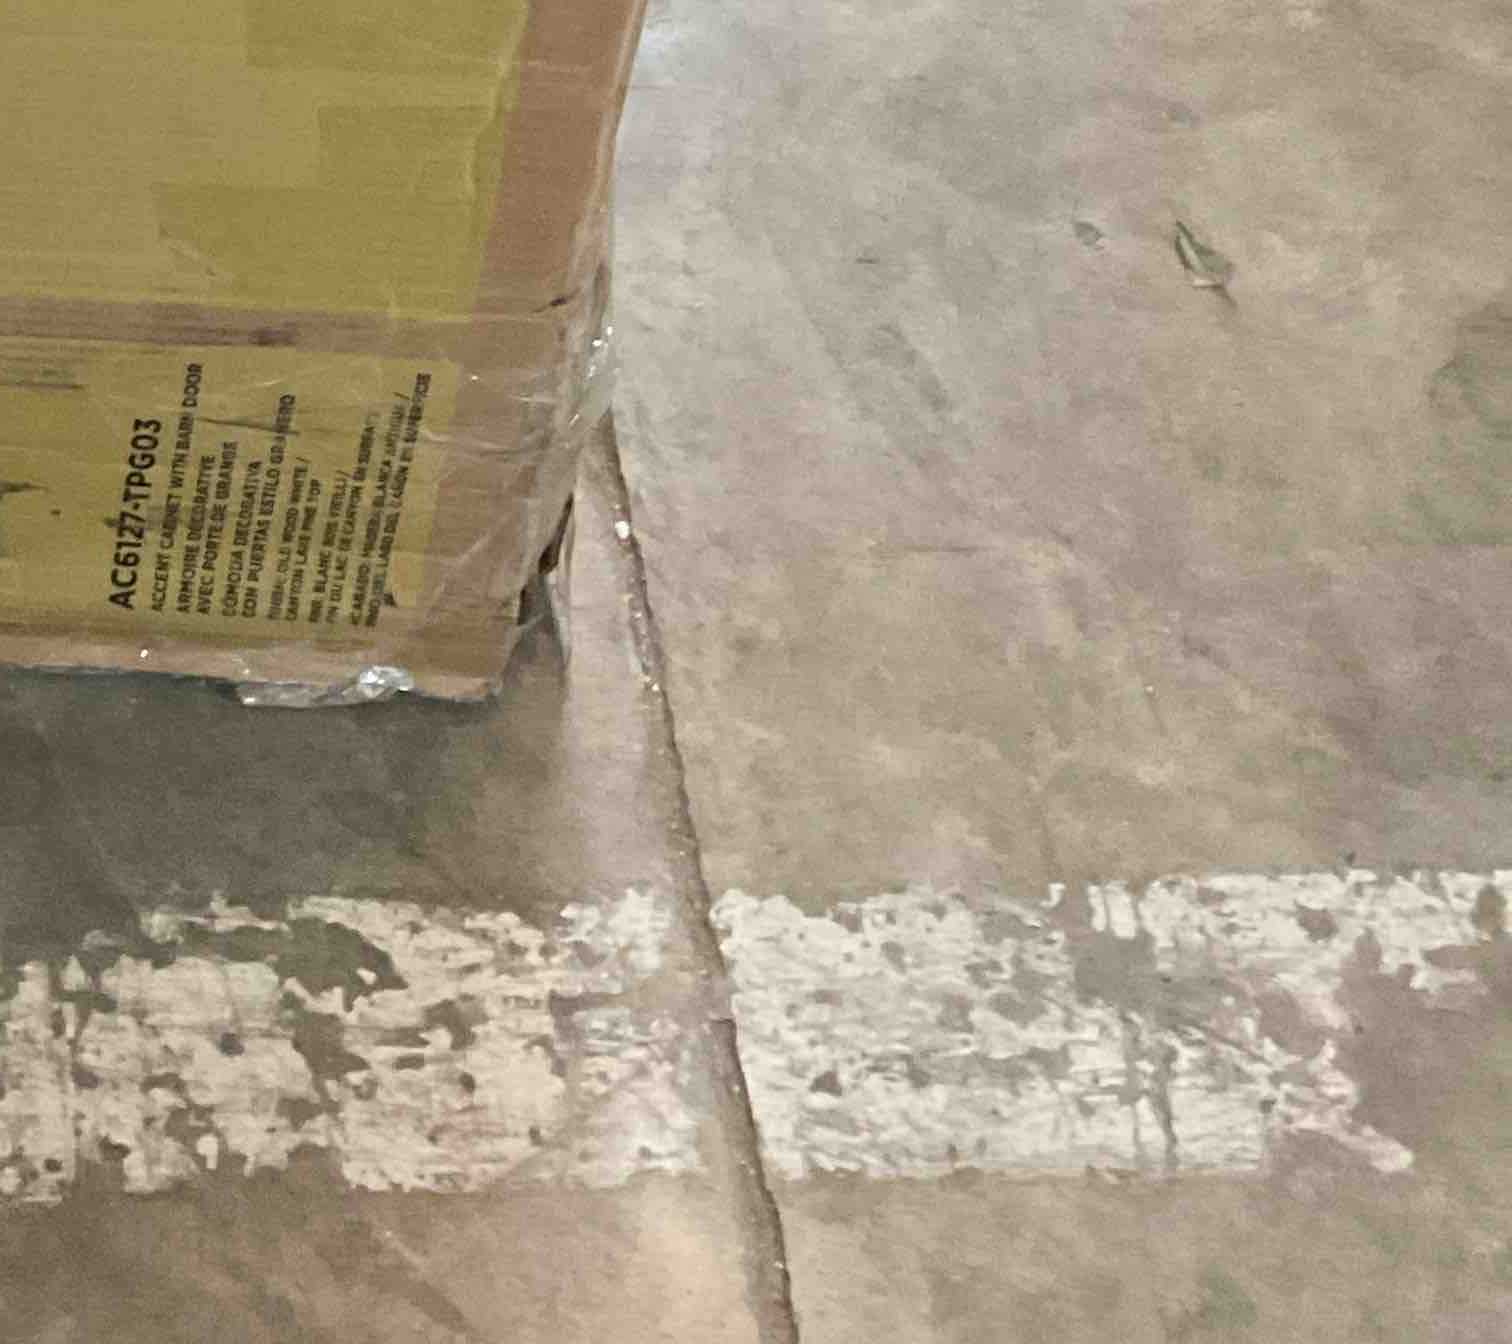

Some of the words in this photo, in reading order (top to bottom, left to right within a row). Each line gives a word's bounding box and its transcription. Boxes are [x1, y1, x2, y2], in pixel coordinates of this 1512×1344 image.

[108, 418, 163, 611] AC6127-TPG03
[151, 552, 169, 613] ACCENT
[182, 363, 203, 408] DOOR
[196, 567, 215, 615] AVEC
